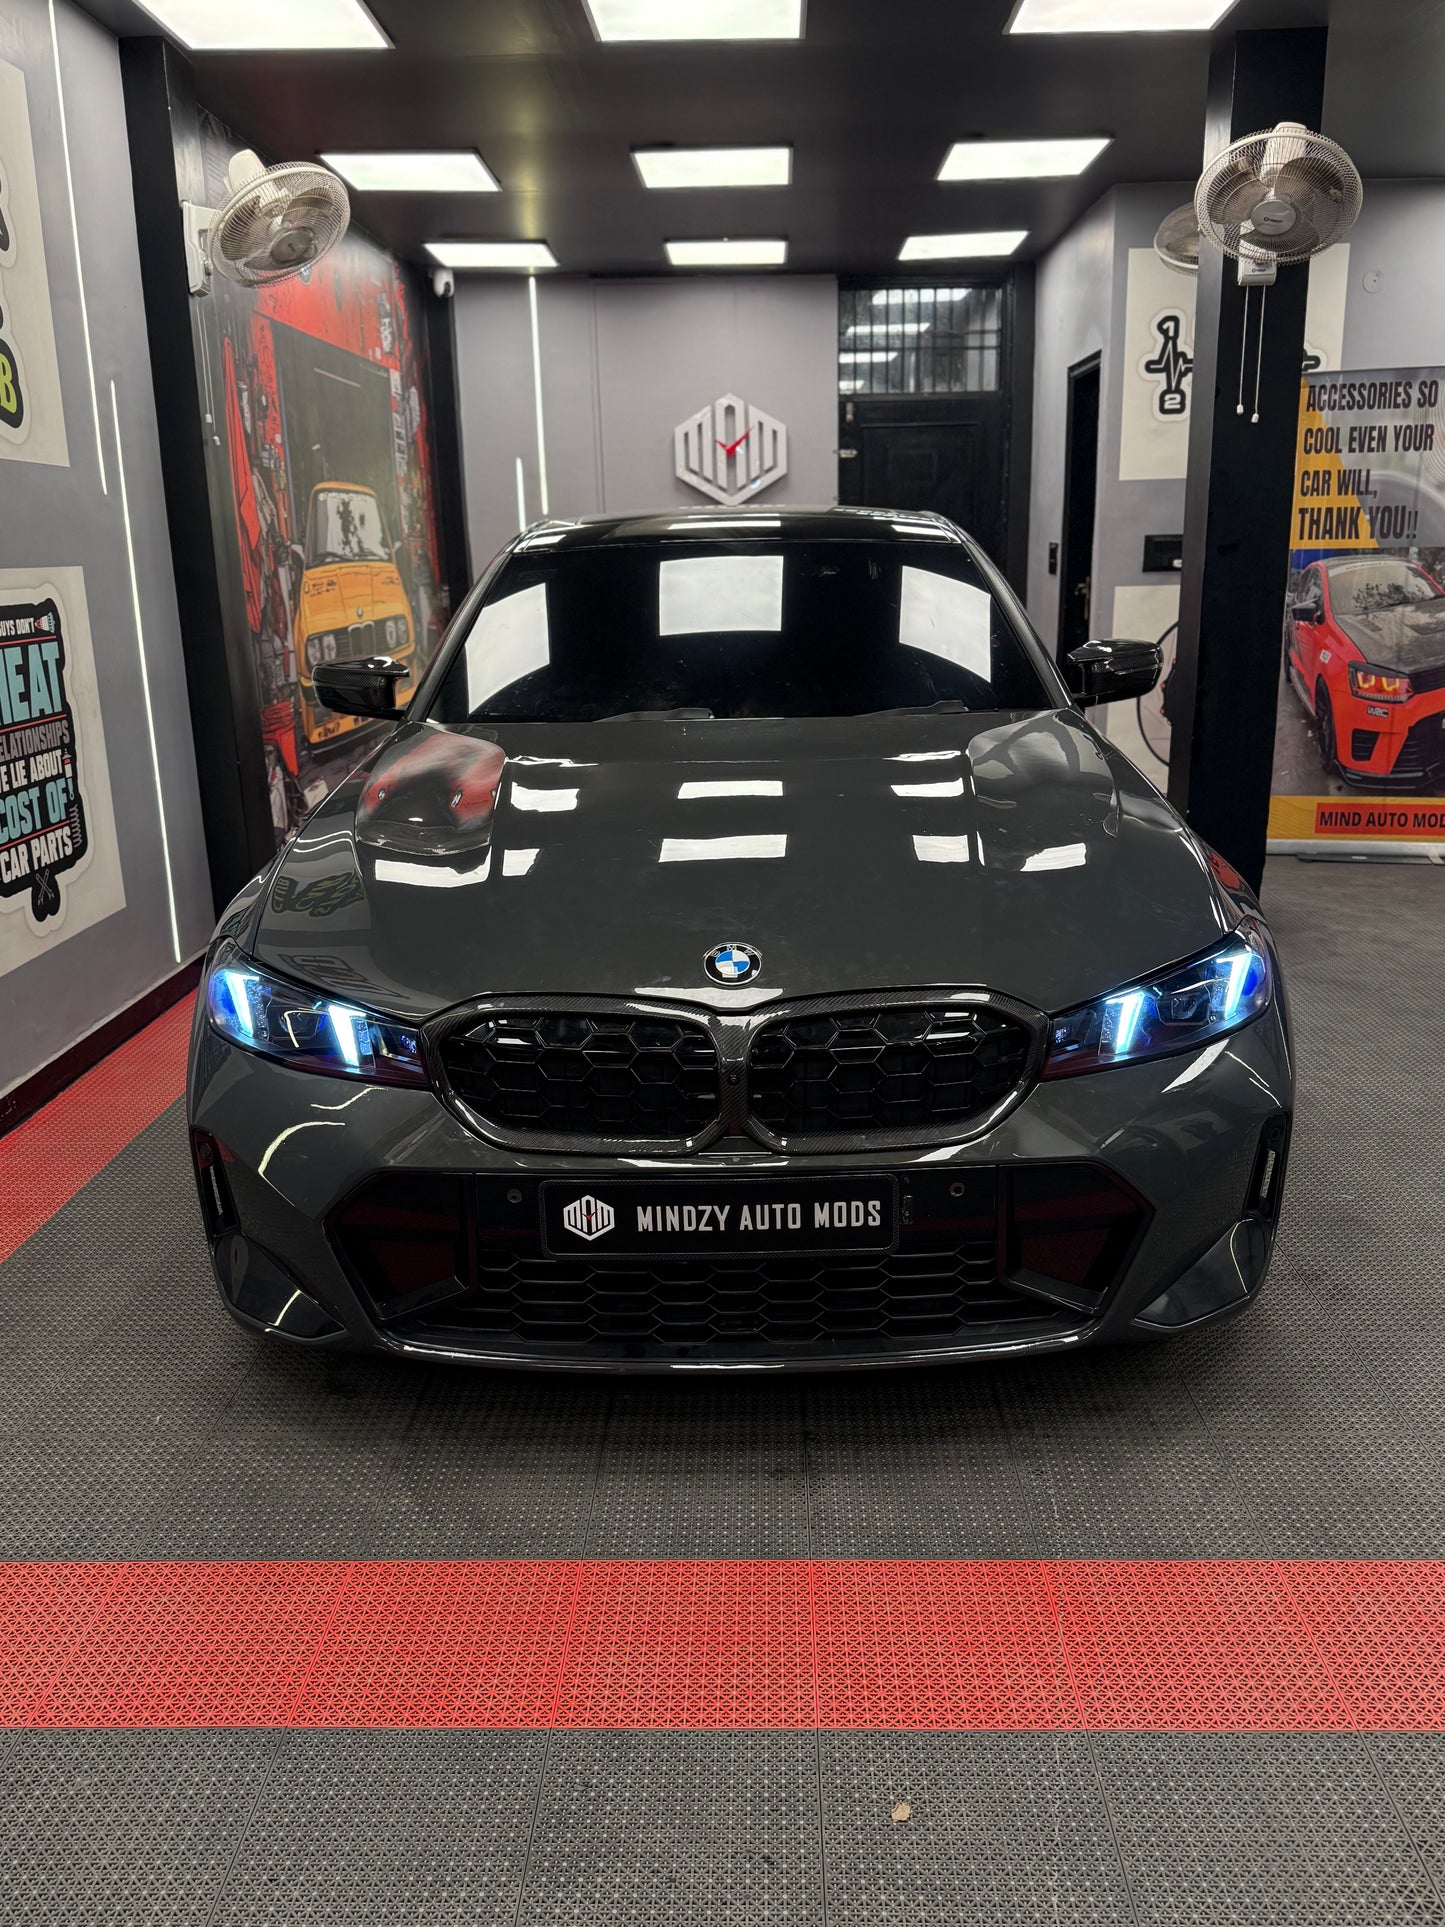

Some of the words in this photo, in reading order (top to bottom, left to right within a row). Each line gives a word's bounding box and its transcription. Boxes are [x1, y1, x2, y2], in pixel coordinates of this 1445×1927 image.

[1307, 382, 1412, 411] ACCESSORIES
[1417, 380, 1438, 408] SO
[1304, 427, 1342, 454] COOL
[1348, 425, 1388, 453] EVEN
[1394, 424, 1435, 451] YOUR
[1300, 470, 1331, 497] CAR
[1337, 469, 1377, 498] WILL,
[1299, 507, 1362, 539] THANK
[1368, 505, 1418, 539] YOU!!
[10, 759, 28, 790] LIE
[30, 749, 62, 783] ABOUT
[45, 777, 68, 824] OF
[1320, 811, 1362, 827] MIND
[1365, 812, 1408, 828] AUTO
[0, 843, 30, 884] CAR
[30, 825, 73, 870] PARTS
[637, 1205, 730, 1232] MINDZY
[739, 1203, 801, 1231] AUTO
[814, 1200, 881, 1229] MODS
